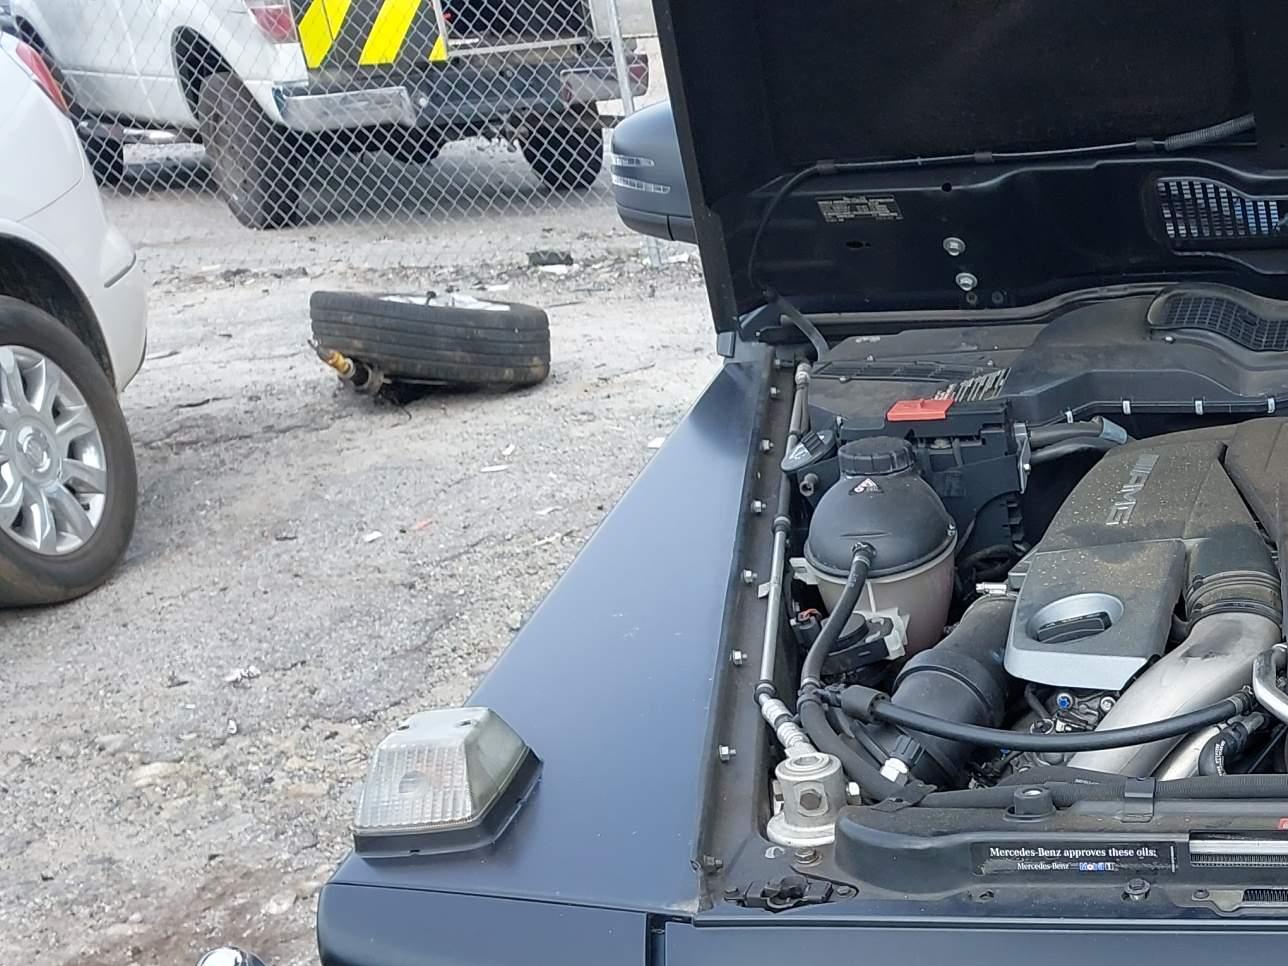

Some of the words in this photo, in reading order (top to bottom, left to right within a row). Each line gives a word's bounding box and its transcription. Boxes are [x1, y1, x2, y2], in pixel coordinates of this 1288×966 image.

[989, 847, 1062, 857] Mercedes-Benz
[1063, 847, 1106, 860] approves
[1108, 846, 1135, 857] these
[1017, 862, 1069, 871] Mercedes-Benz
